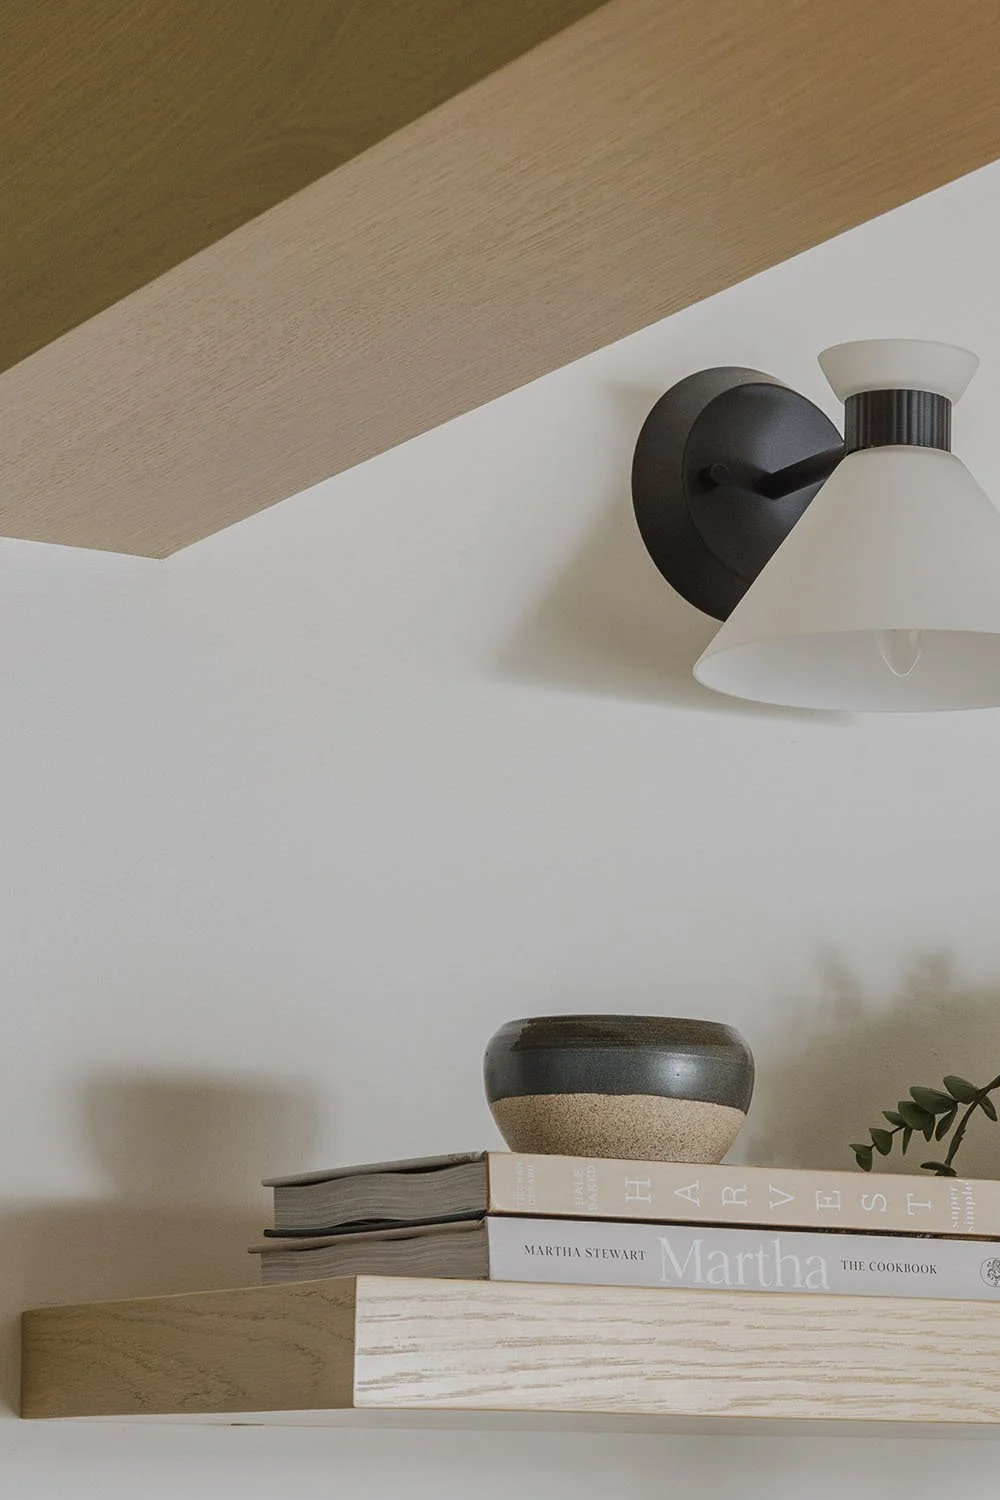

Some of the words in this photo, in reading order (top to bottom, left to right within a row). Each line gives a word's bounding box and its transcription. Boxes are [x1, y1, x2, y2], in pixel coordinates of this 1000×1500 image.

[586, 1165, 598, 1211] BAKED
[948, 1183, 961, 1229] super
[962, 1181, 977, 1233] simple
[524, 1244, 581, 1259] MARTHA
[585, 1248, 648, 1261] STEWART
[657, 1236, 831, 1290] Martha
[841, 1260, 865, 1272] THE
[868, 1261, 938, 1275] COOKBOOK
